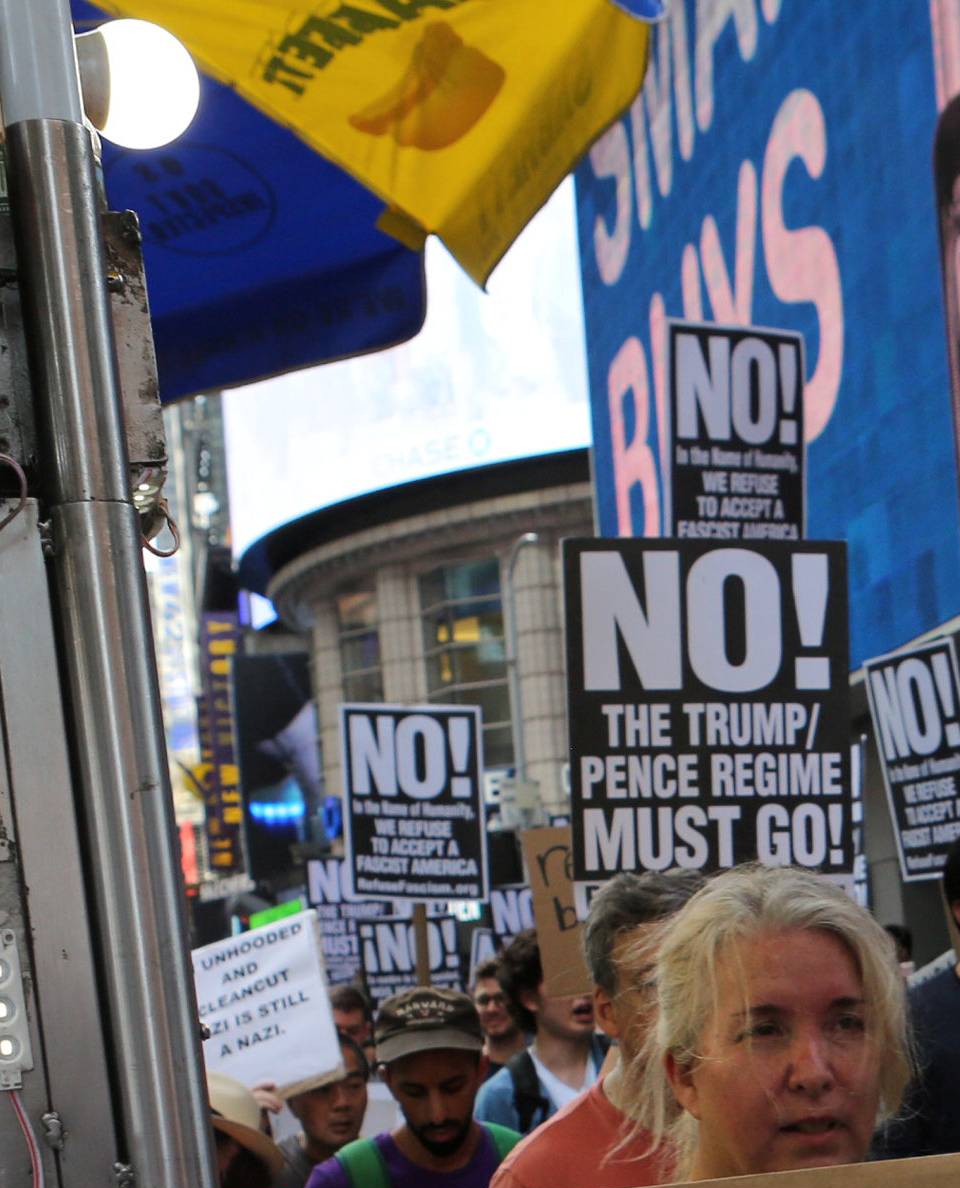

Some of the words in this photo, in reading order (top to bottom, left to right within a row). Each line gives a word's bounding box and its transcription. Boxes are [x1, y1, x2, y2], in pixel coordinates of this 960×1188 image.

[675, 333, 797, 445] NO!
[701, 471, 729, 493] WE
[730, 472, 780, 495] REFUSE
[696, 495, 718, 518] TO
[720, 496, 772, 519] ACCEPT
[773, 498, 785, 520] A
[677, 519, 741, 539] FASCIST
[579, 547, 832, 693] NO!
[601, 703, 672, 748] THE
[683, 702, 821, 750] TRUMP/
[348, 713, 473, 799] NO!
[580, 753, 699, 800] PENCE
[711, 752, 843, 798] REGIME
[374, 818, 397, 837] WE
[398, 819, 453, 838] REFUSE
[583, 804, 742, 872] MUST
[755, 802, 845, 868] GO!
[370, 837, 390, 854] TO
[390, 838, 446, 856] ACCEPT
[447, 839, 460, 857] A
[355, 855, 410, 874] FASCIST
[411, 857, 479, 876] AMERICA
[201, 922, 303, 972] UNHOODED
[221, 961, 259, 985] AND
[234, 1010, 253, 1026] IS
[258, 989, 311, 1019] STILL
[219, 1043, 233, 1058] A
